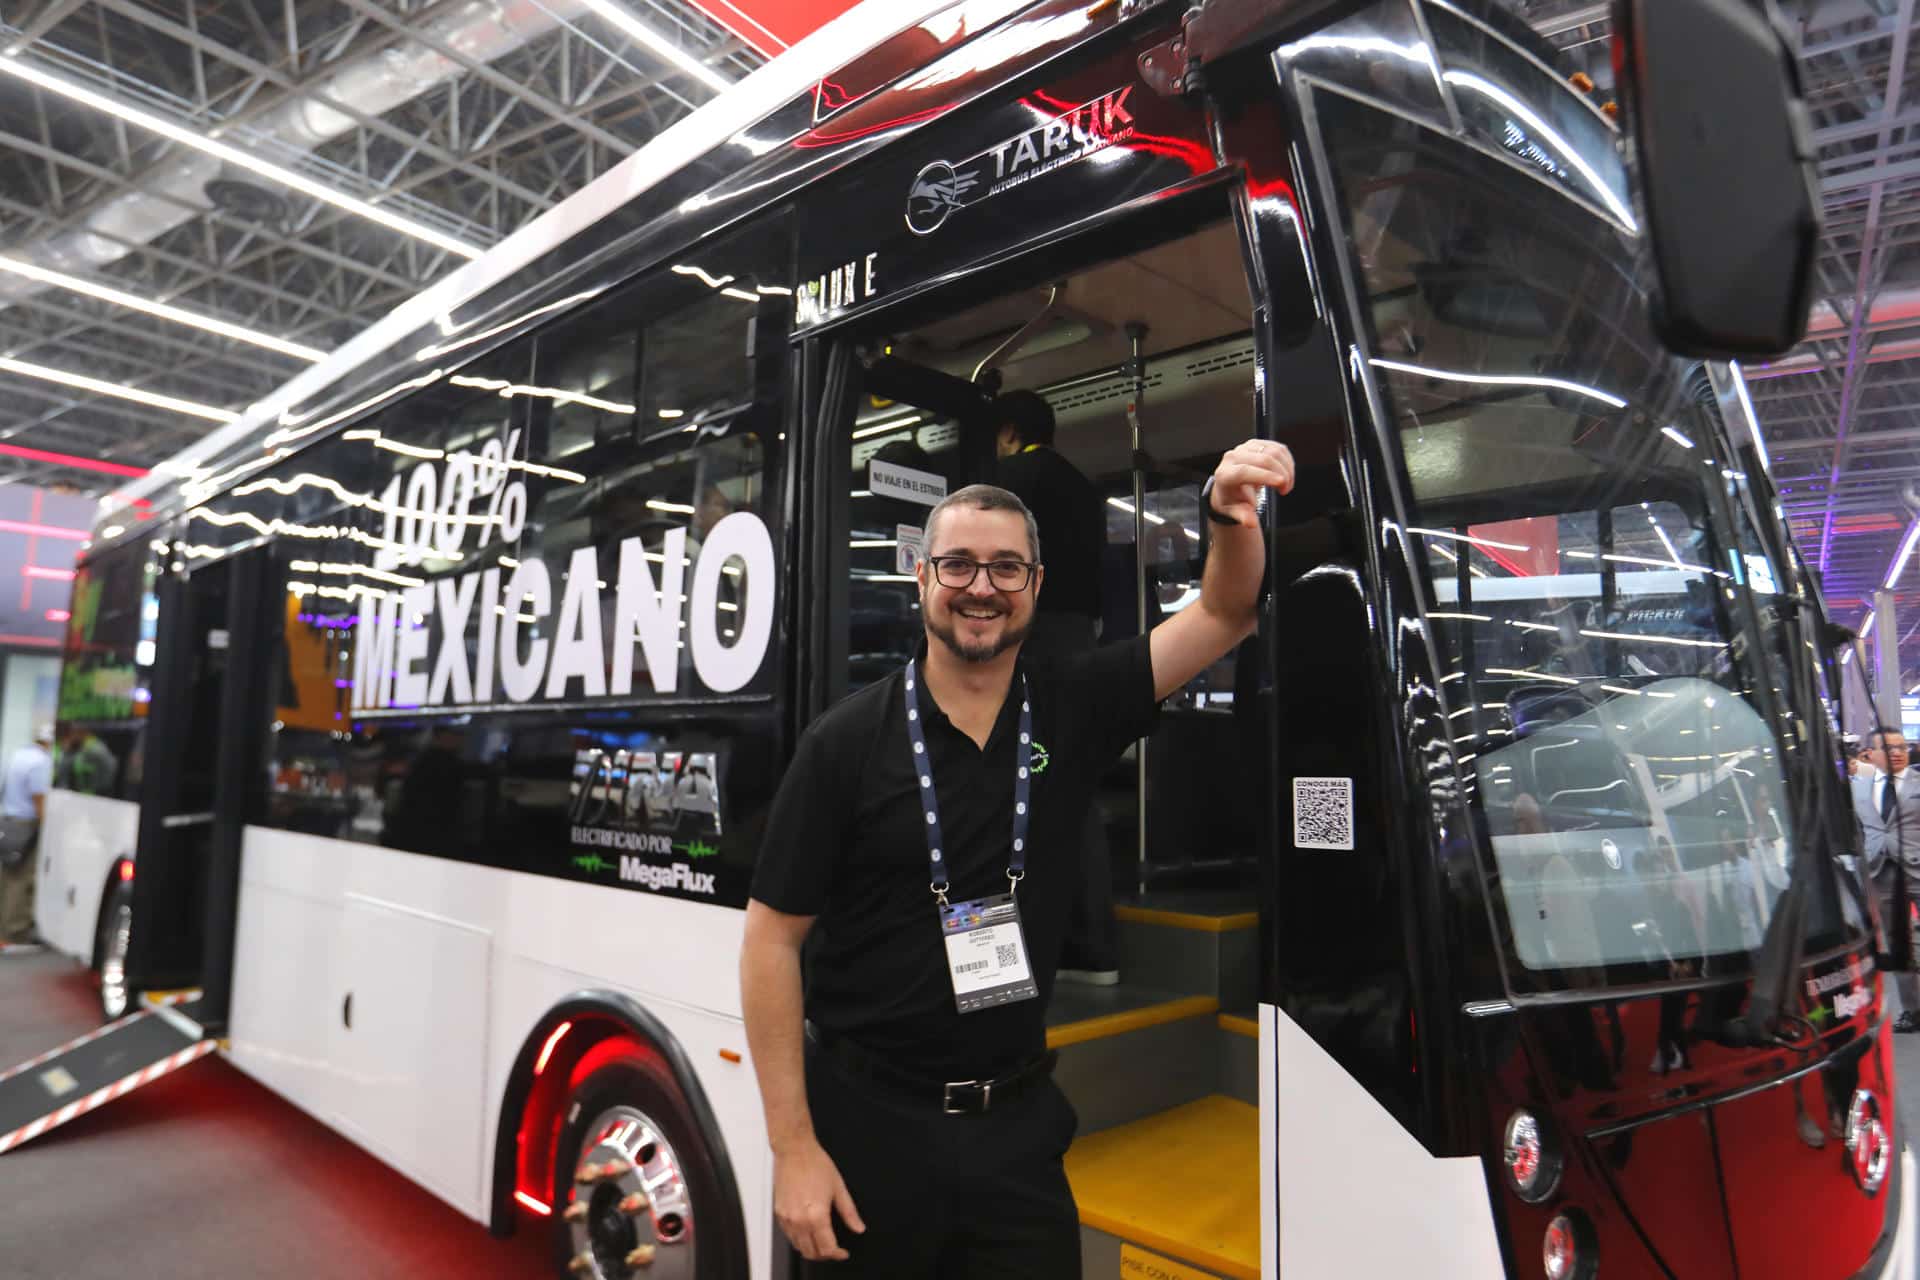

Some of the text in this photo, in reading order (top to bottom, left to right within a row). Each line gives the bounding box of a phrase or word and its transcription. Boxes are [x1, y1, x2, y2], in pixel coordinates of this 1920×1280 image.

[989, 85, 1133, 178] TARUK
[988, 172, 1029, 196] AUTOBUS
[374, 427, 528, 570] 100%
[352, 511, 776, 709] MEXICANO
[571, 825, 673, 855] ELECTRIFICADO POR
[619, 855, 716, 895] MegaFlux
